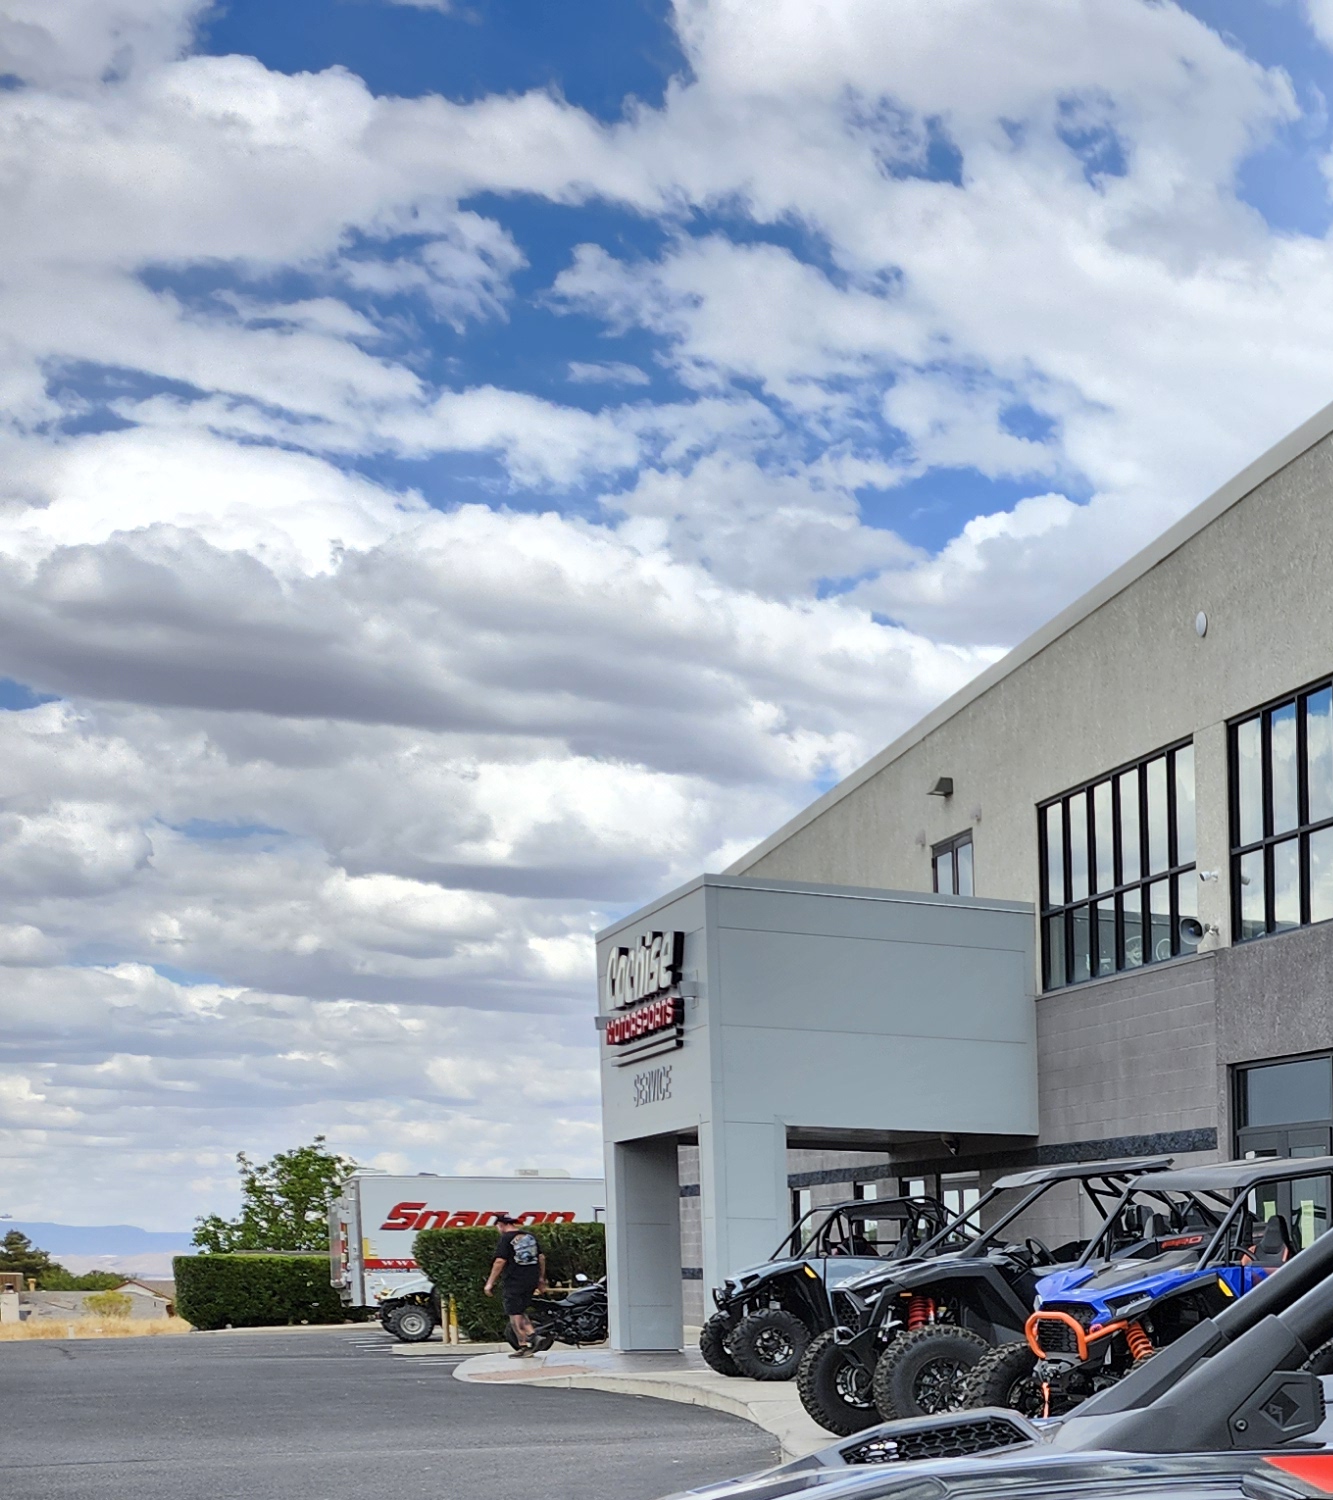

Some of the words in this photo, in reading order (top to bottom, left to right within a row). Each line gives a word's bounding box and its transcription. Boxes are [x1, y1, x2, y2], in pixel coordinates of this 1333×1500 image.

[605, 931, 683, 1011] Cochise
[606, 997, 683, 1046] MOTORSPORTS
[633, 1064, 673, 1108] SERVICE
[379, 1201, 576, 1231] Snapon
